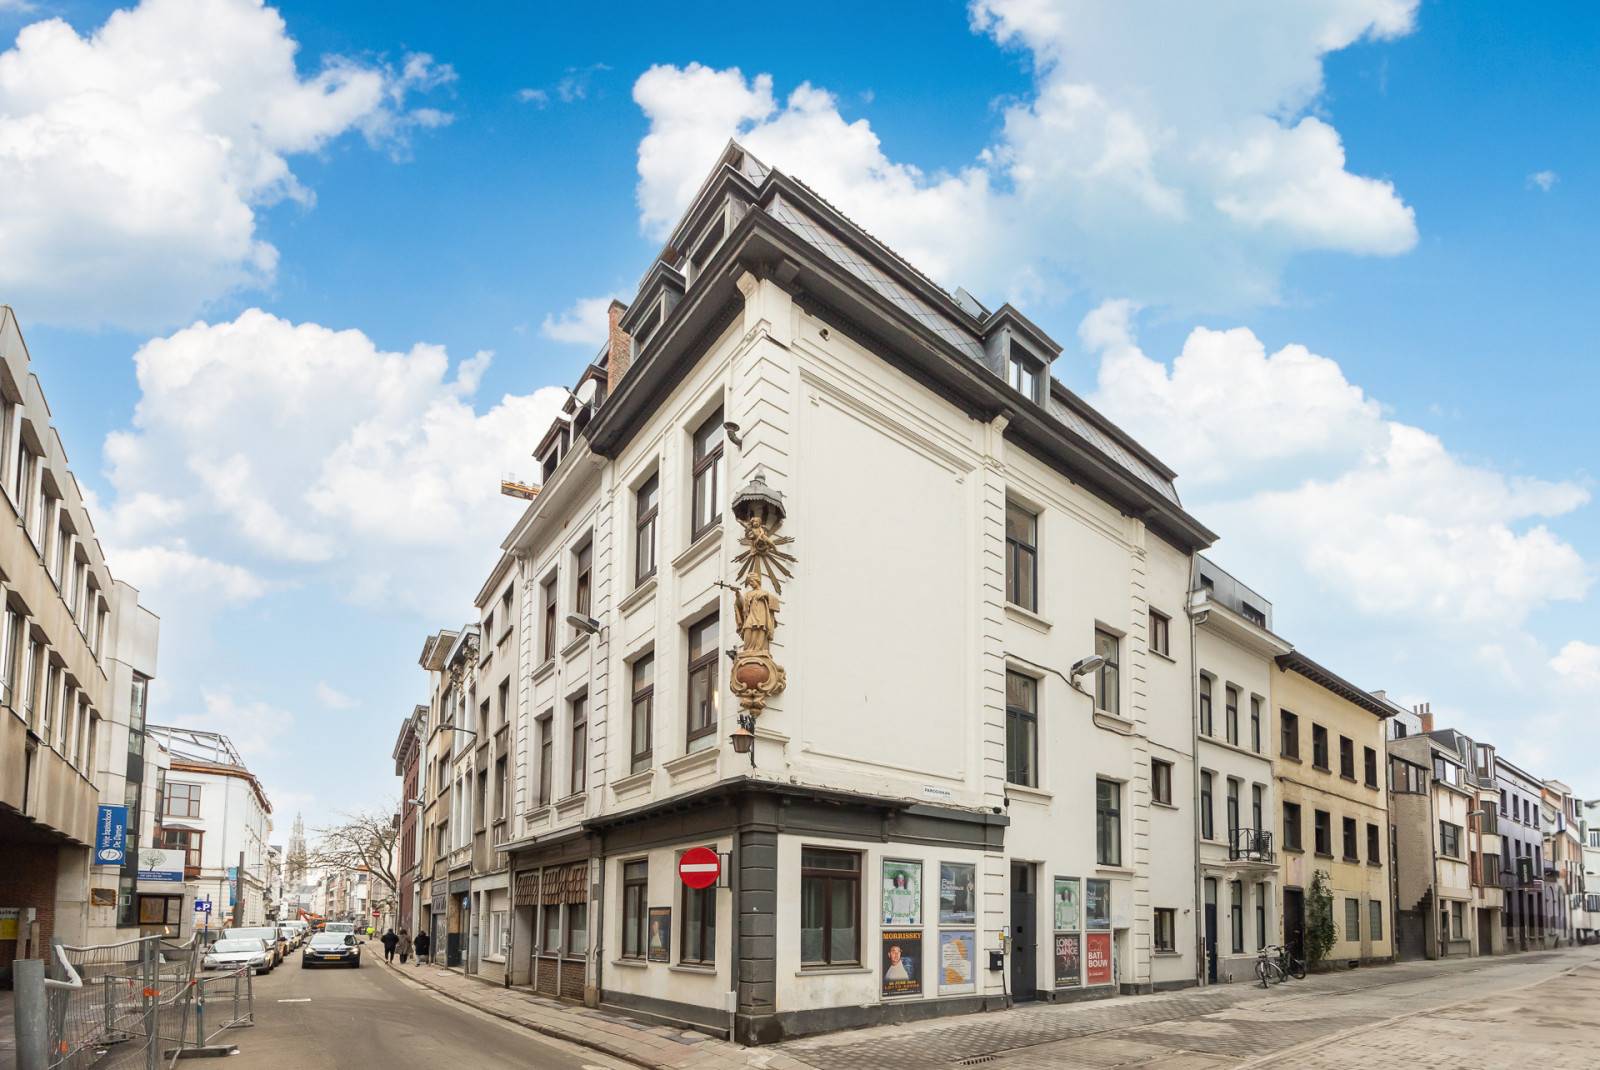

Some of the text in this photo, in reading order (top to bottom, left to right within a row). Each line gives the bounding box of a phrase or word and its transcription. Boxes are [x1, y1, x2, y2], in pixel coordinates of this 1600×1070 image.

[883, 932, 922, 940] MORRISSEY
[1056, 938, 1073, 947] LORD
[1056, 946, 1079, 956] DANCE
[1088, 951, 1103, 960] BATI
[1088, 959, 1109, 968] BOUW
